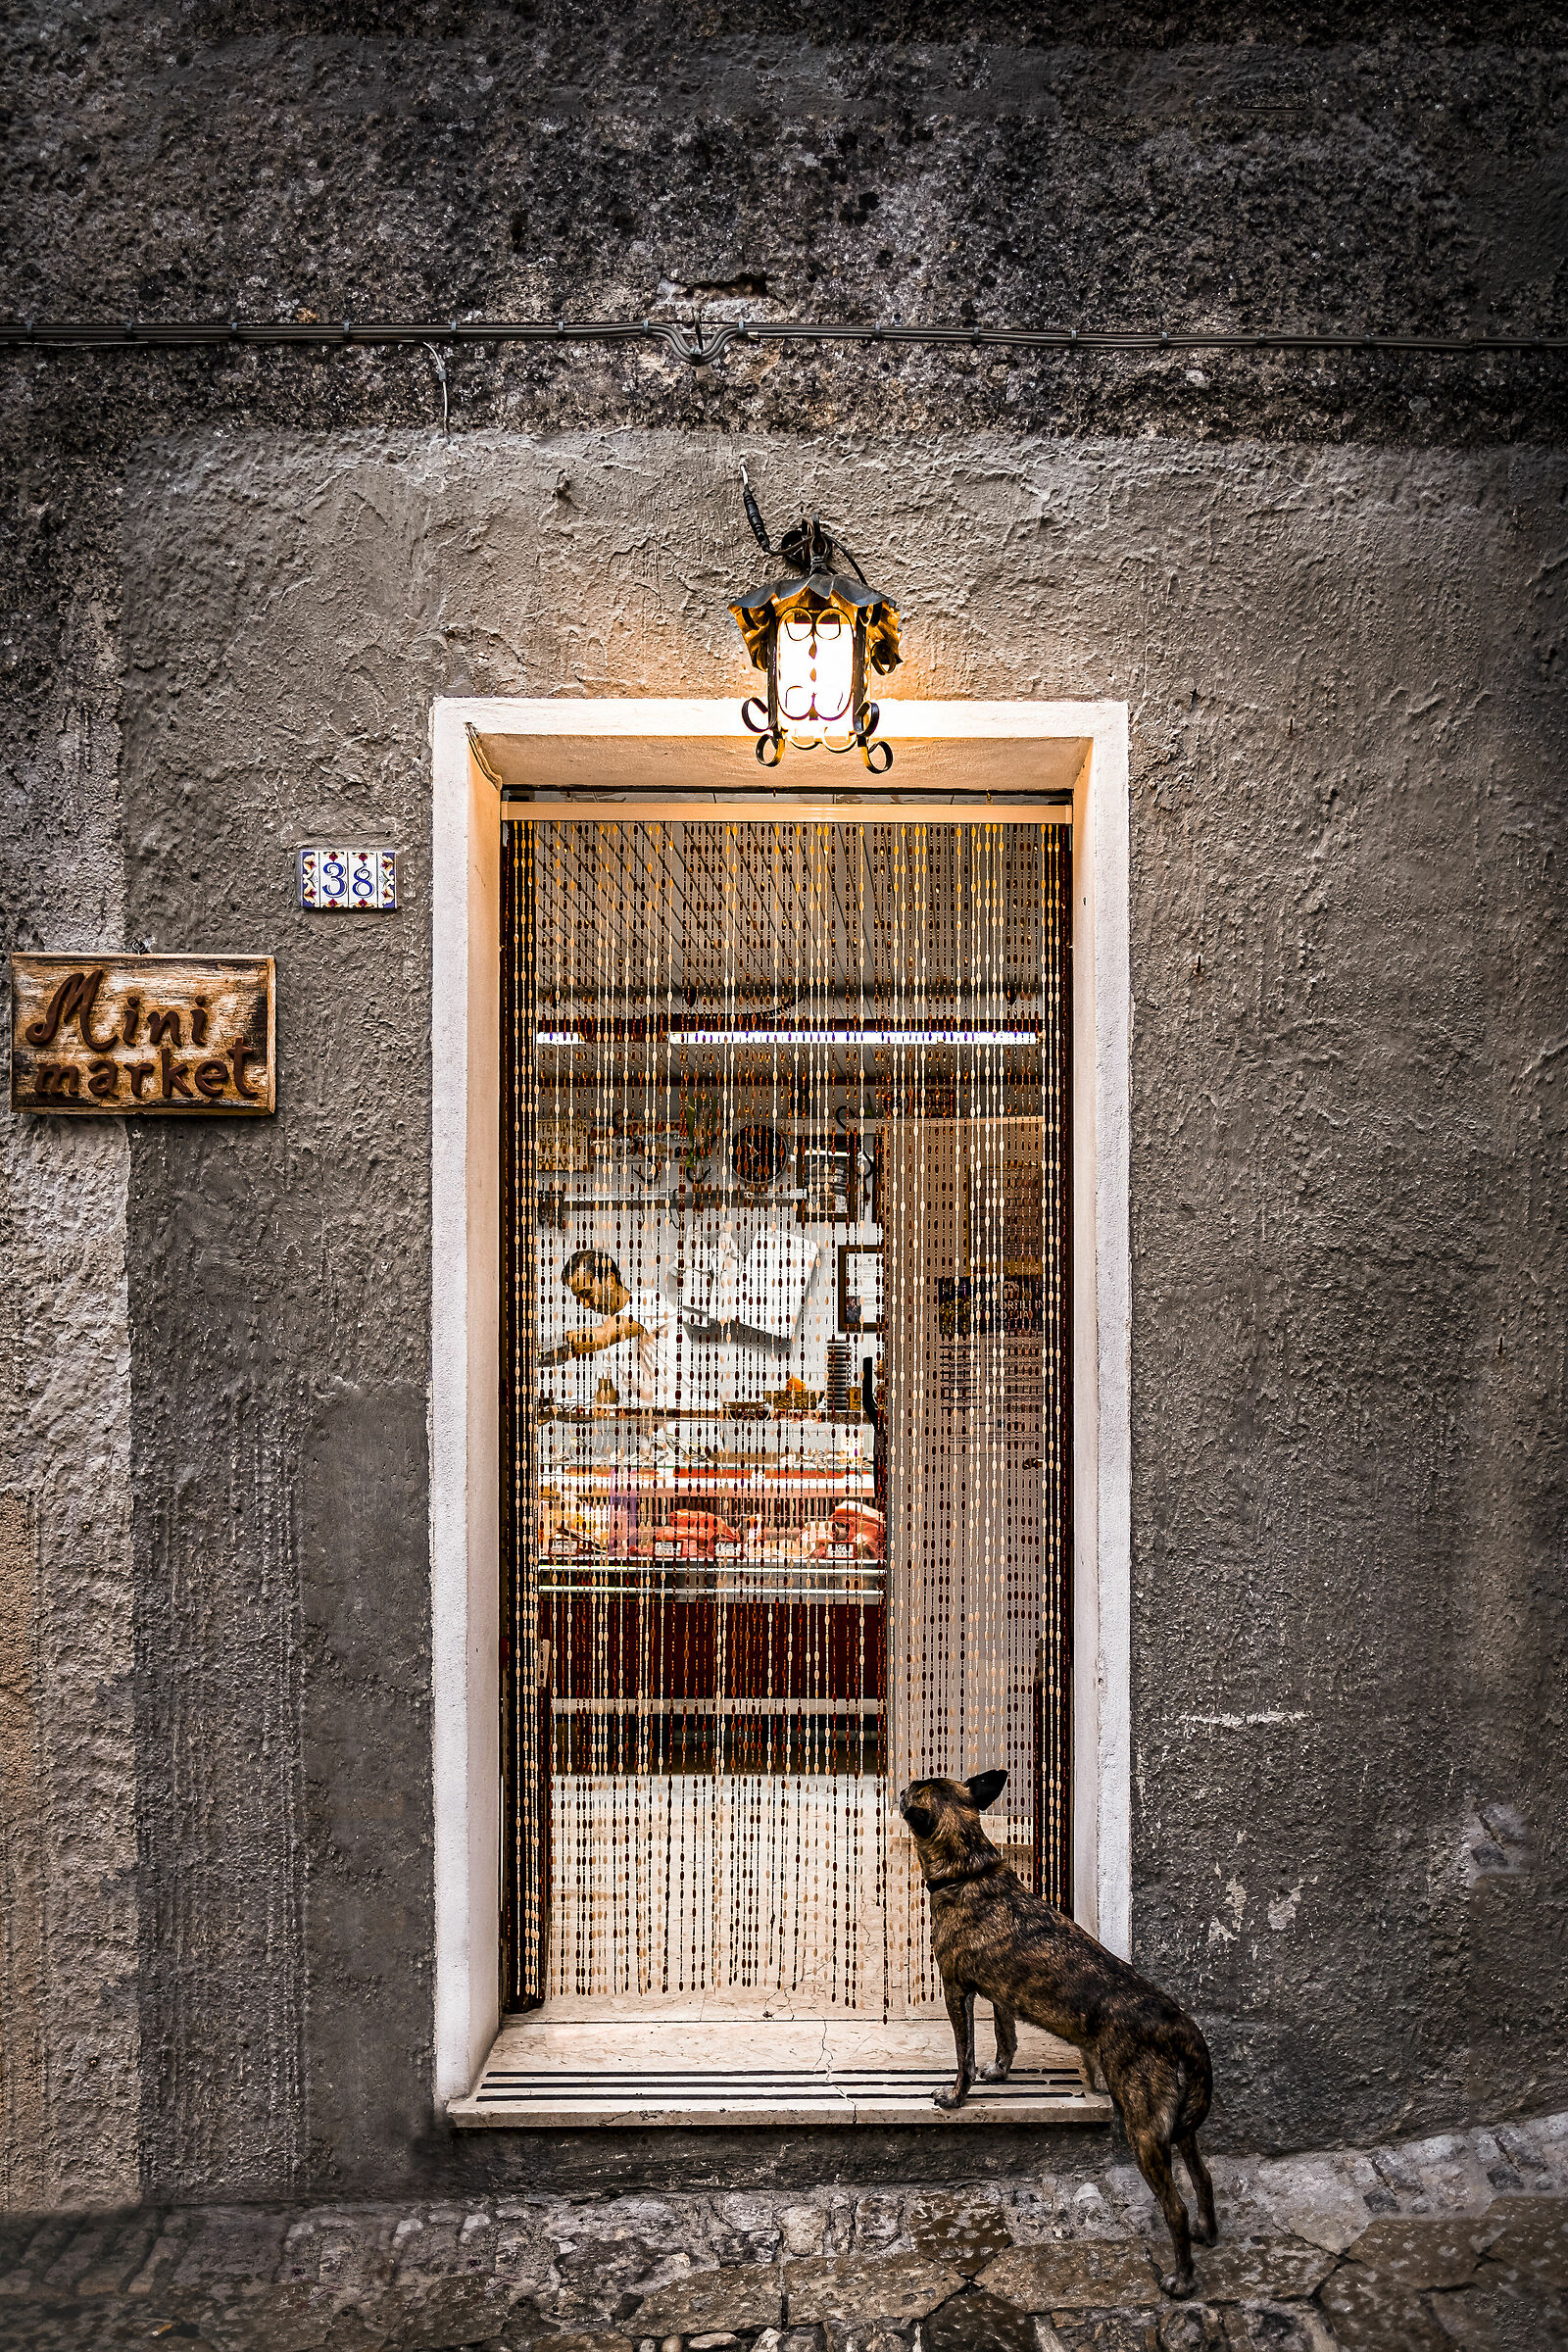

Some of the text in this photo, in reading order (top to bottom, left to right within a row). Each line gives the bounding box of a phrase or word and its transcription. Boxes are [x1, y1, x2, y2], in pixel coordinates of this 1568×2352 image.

[322, 861, 376, 898] 38
[25, 969, 209, 1052] Mini
[34, 1037, 258, 1098] market
